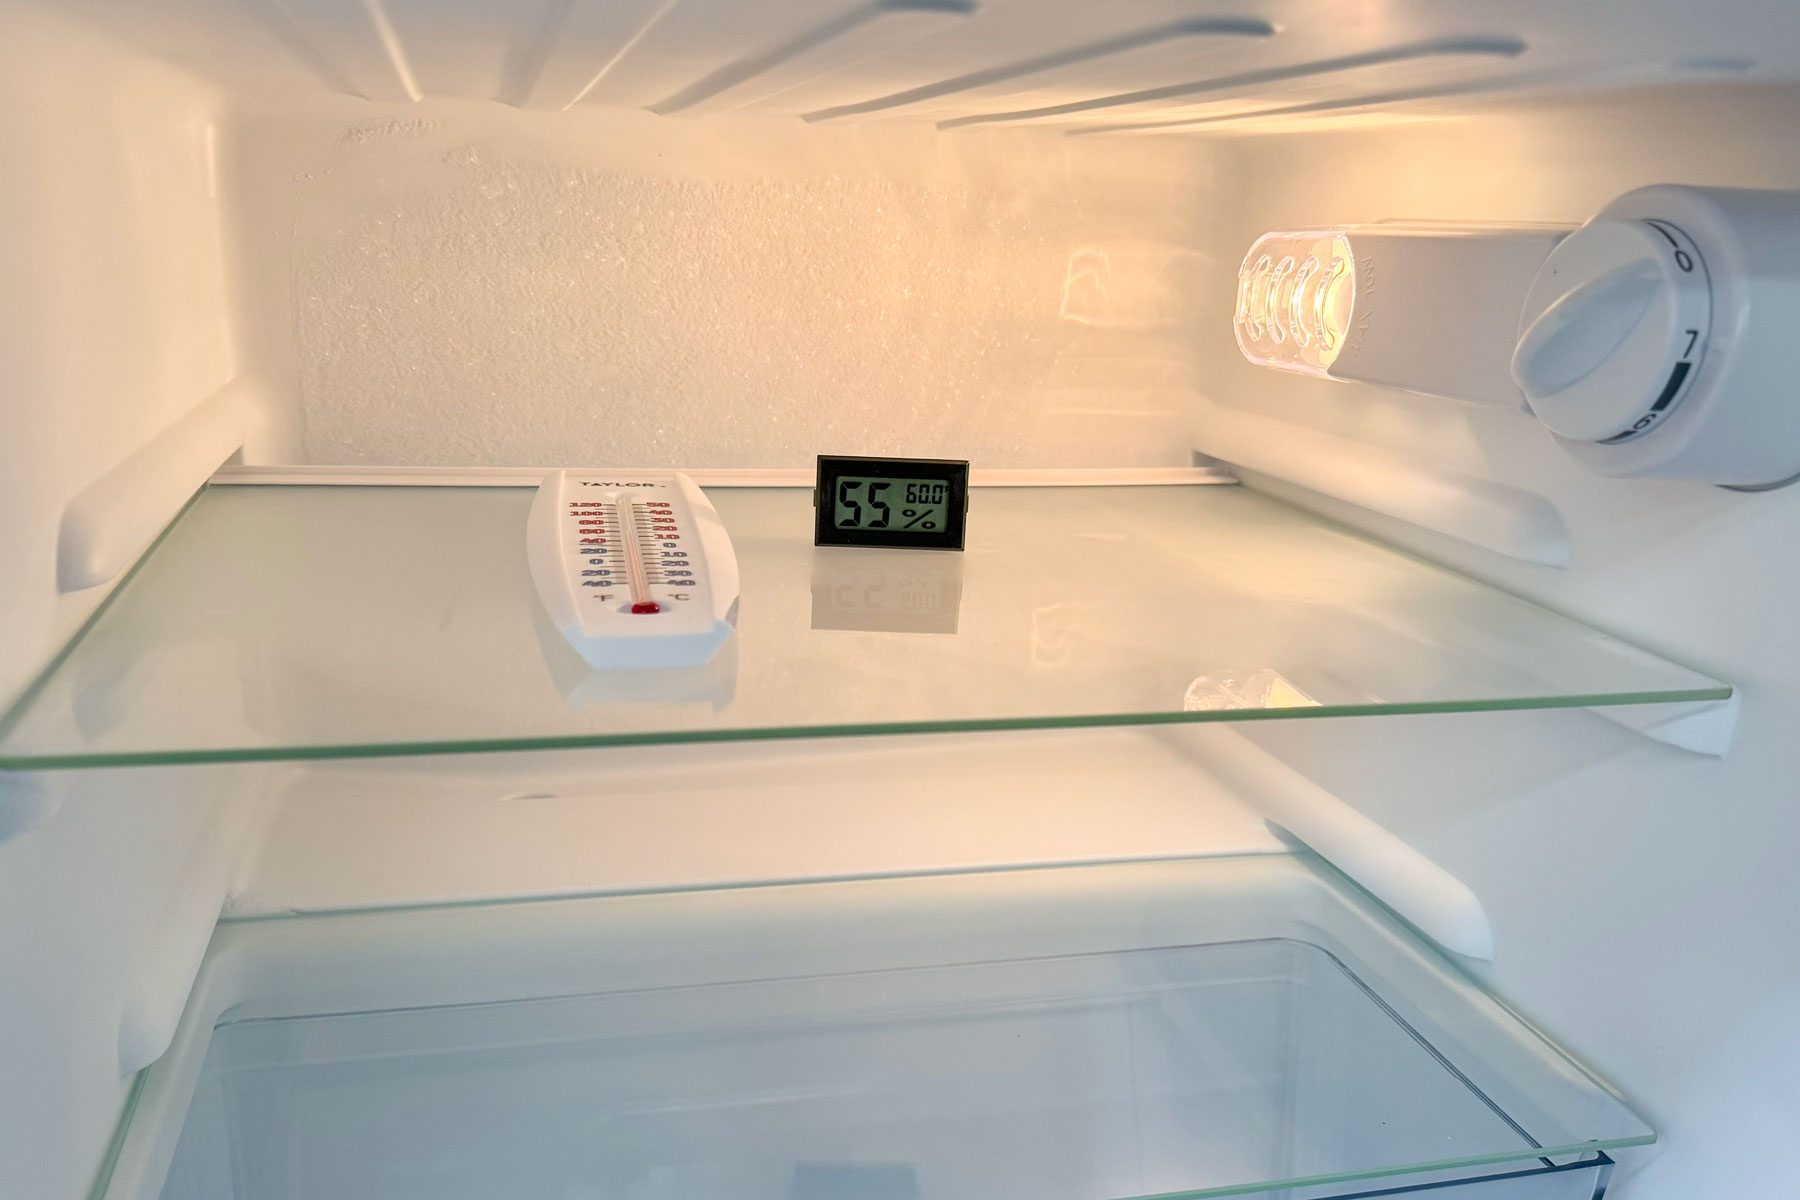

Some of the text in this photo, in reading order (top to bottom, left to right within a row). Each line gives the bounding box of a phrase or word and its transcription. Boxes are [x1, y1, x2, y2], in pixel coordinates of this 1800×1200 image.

[1683, 329, 1699, 359] 7
[838, 480, 892, 529] 55
[581, 569, 611, 577] 20
[581, 580, 613, 588] 40
[666, 579, 696, 587] 40
